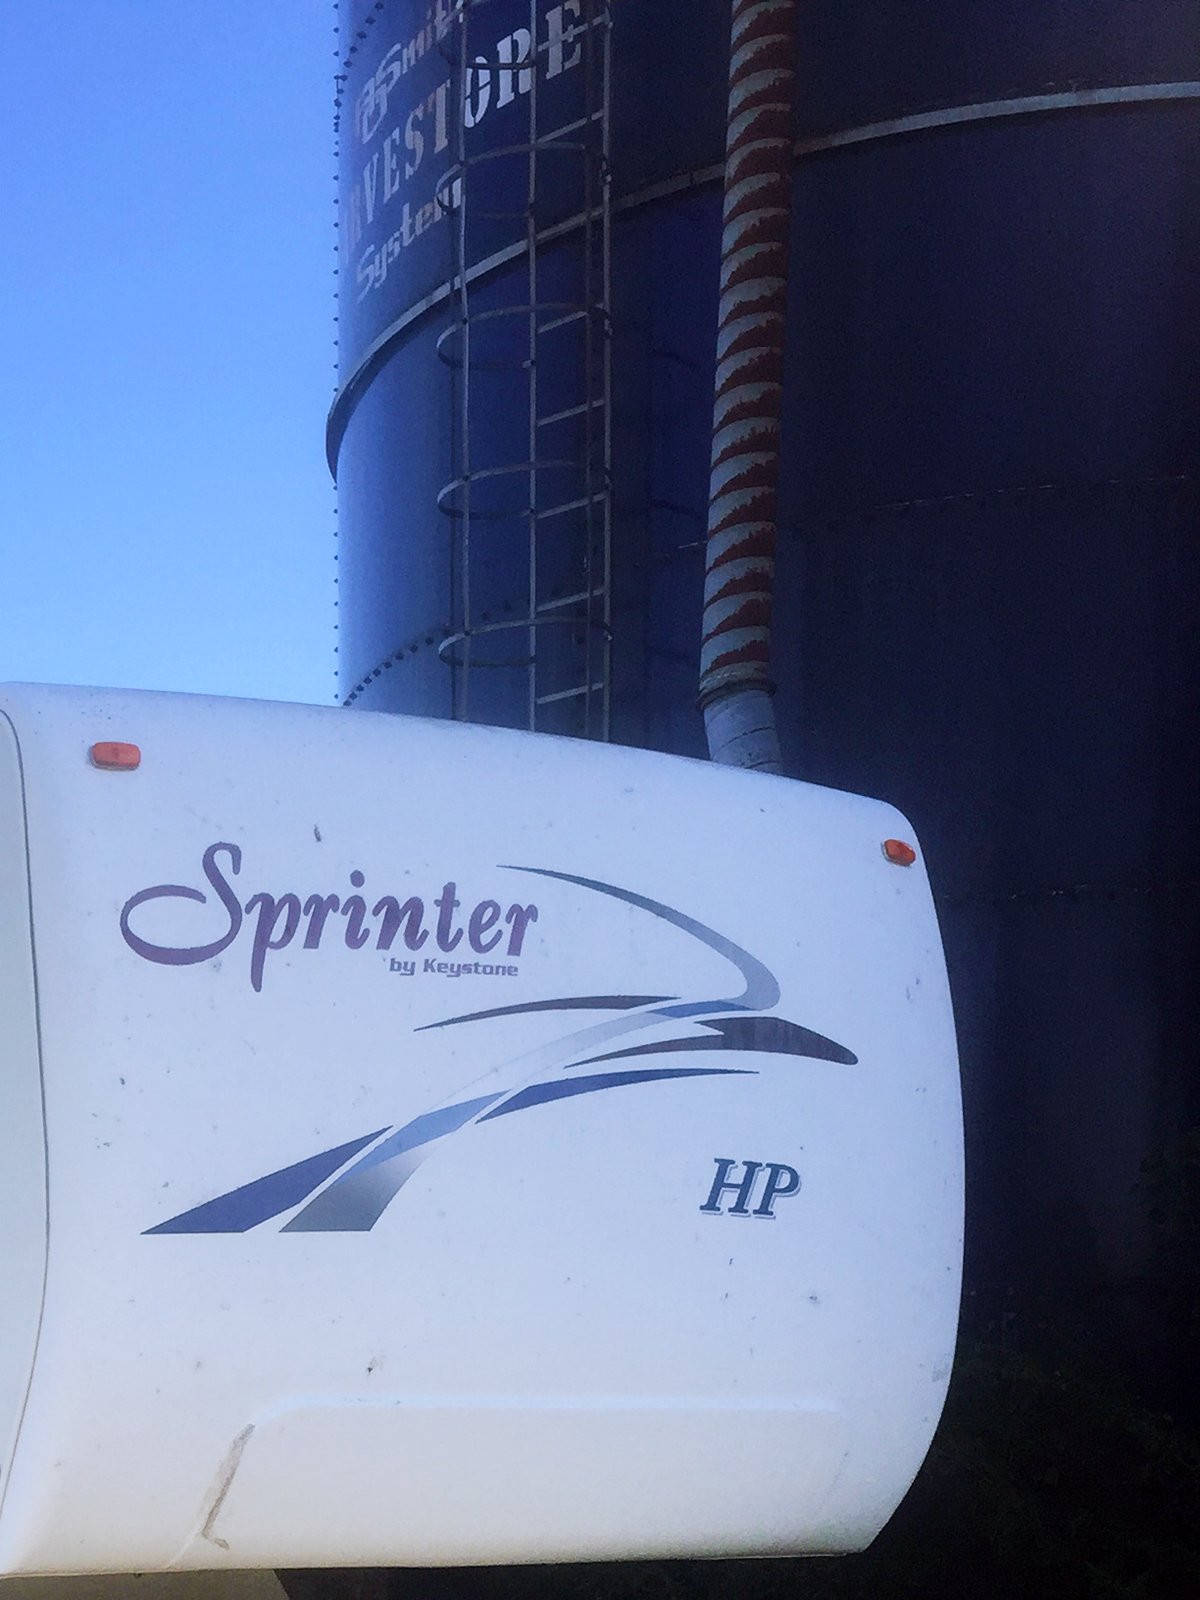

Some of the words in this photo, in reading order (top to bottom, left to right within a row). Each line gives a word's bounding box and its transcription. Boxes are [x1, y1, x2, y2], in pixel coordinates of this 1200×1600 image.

[119, 841, 539, 993] Sprinter
[389, 957, 417, 977] by
[423, 957, 520, 979] Keystone
[699, 1157, 802, 1220] HP
